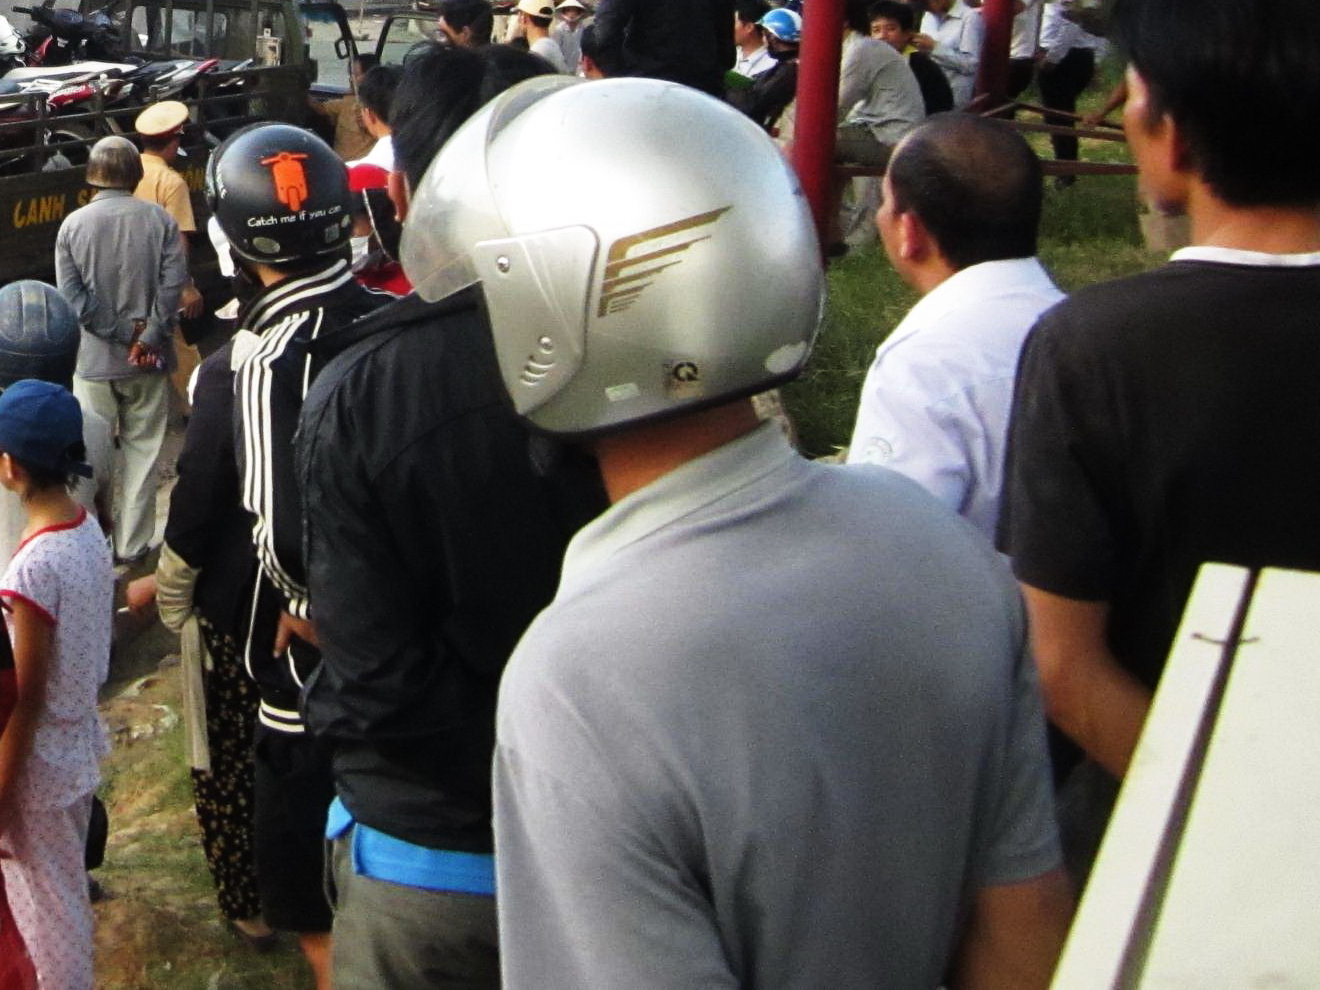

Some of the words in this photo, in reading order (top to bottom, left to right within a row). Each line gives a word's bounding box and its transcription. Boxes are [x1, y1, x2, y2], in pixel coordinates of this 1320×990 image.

[247, 215, 278, 227] Catch
[280, 215, 297, 224] me
[299, 210, 307, 221] if
[309, 209, 327, 220] you
